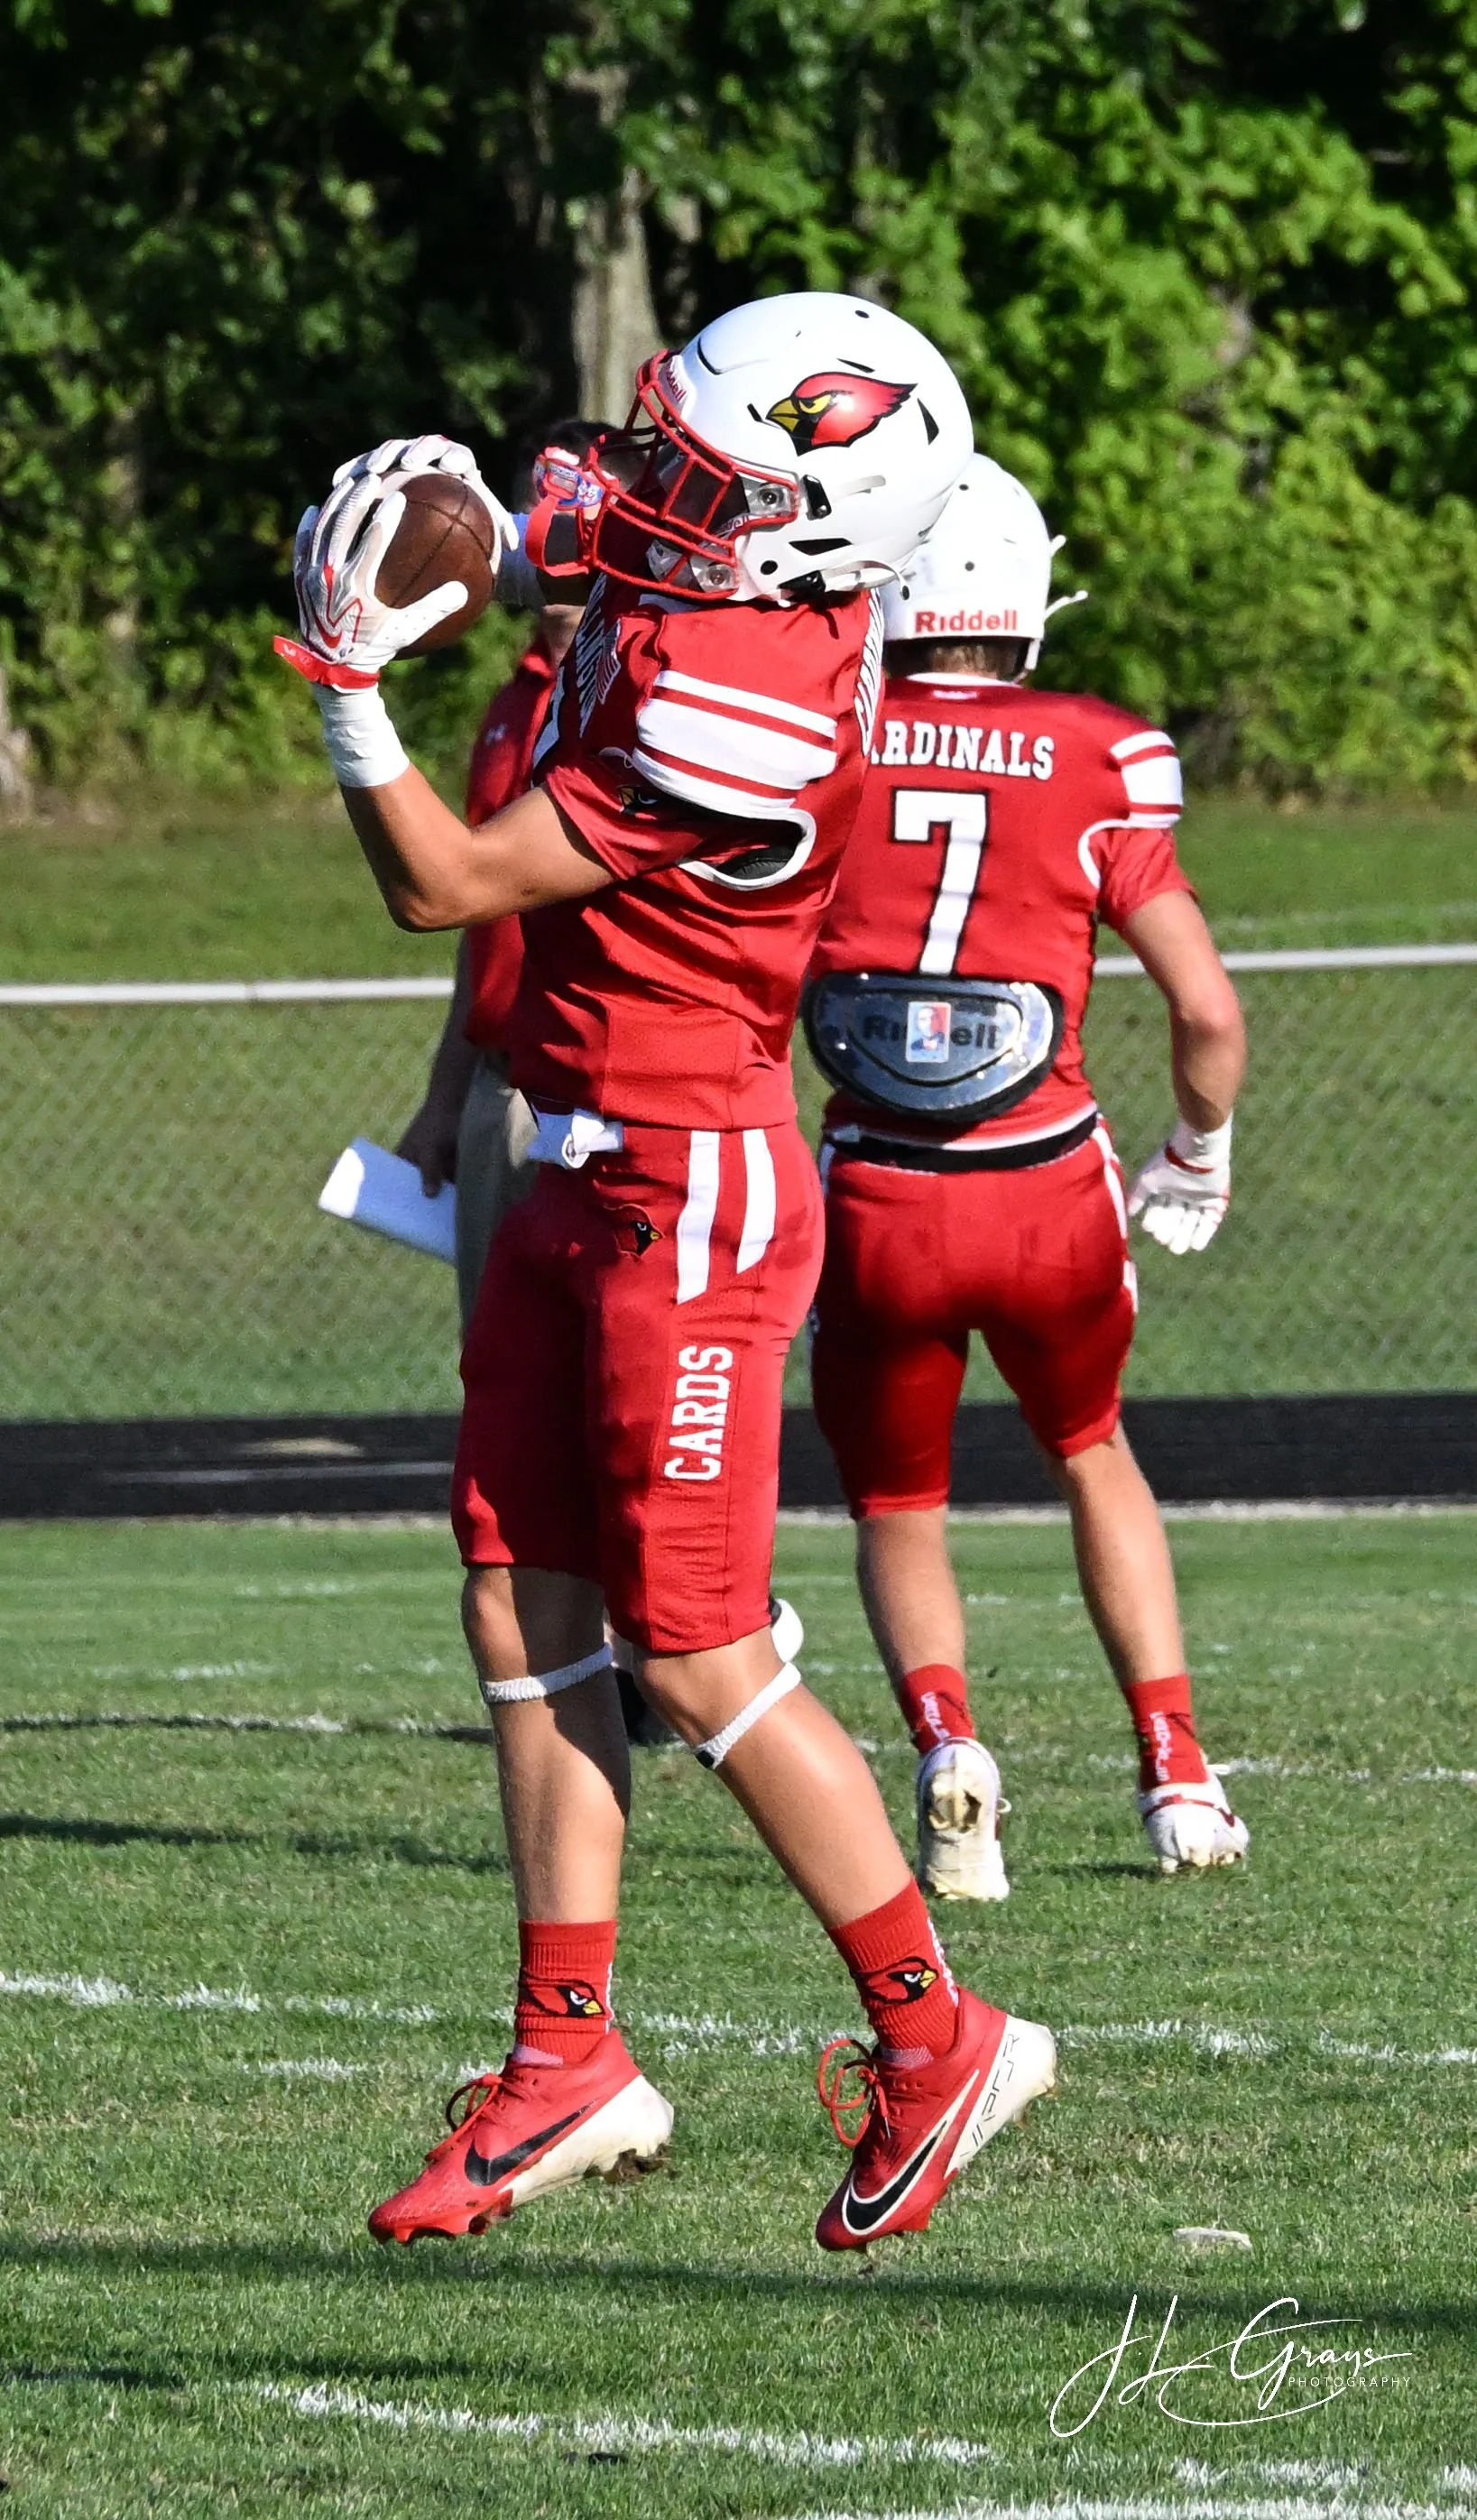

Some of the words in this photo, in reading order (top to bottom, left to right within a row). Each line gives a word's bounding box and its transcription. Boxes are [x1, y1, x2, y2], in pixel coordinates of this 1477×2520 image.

[915, 610, 1018, 632] Riddell
[892, 789, 988, 974] 7
[863, 1015, 1000, 1049] Riell
[663, 1344, 734, 1481] CARDS
